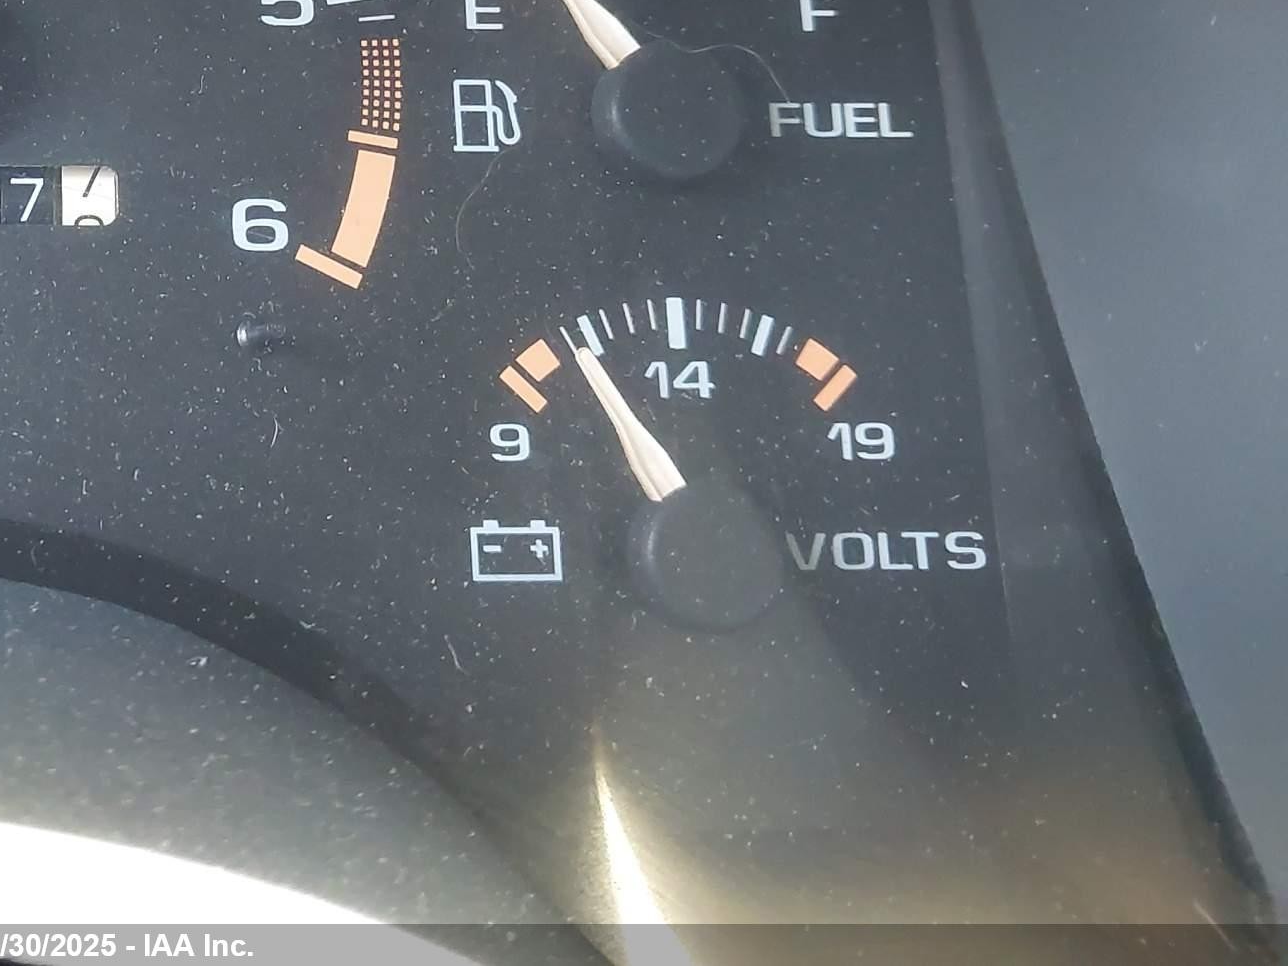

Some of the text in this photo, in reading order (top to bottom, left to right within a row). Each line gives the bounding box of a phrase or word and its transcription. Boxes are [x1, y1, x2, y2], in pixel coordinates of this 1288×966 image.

[768, 102, 914, 138] FUEL
[230, 199, 290, 253] 6
[644, 361, 715, 399] 14
[488, 423, 531, 462] 9
[826, 422, 895, 461] 19
[785, 532, 987, 571] VOLTS
